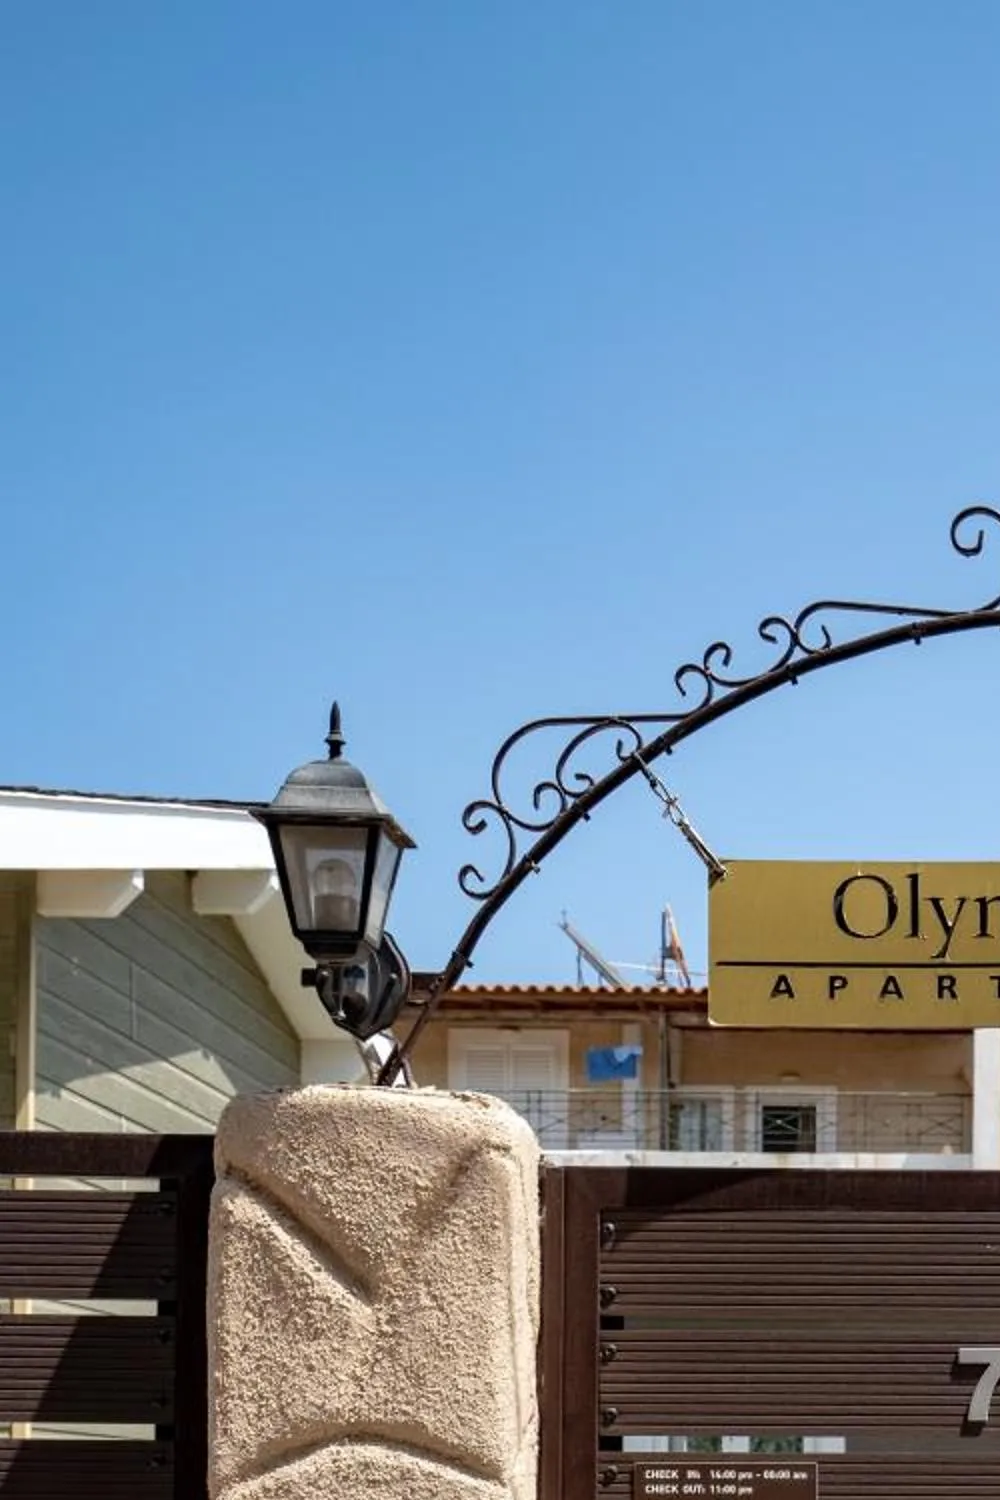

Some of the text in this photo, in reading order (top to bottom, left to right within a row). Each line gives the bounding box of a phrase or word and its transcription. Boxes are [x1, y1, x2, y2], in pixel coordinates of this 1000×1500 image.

[645, 1469, 679, 1480] CHECK
[738, 1471, 753, 1482] pm
[645, 1484, 679, 1495] CHECK
[710, 1484, 737, 1495] 11:00
[738, 1486, 753, 1497] pm
